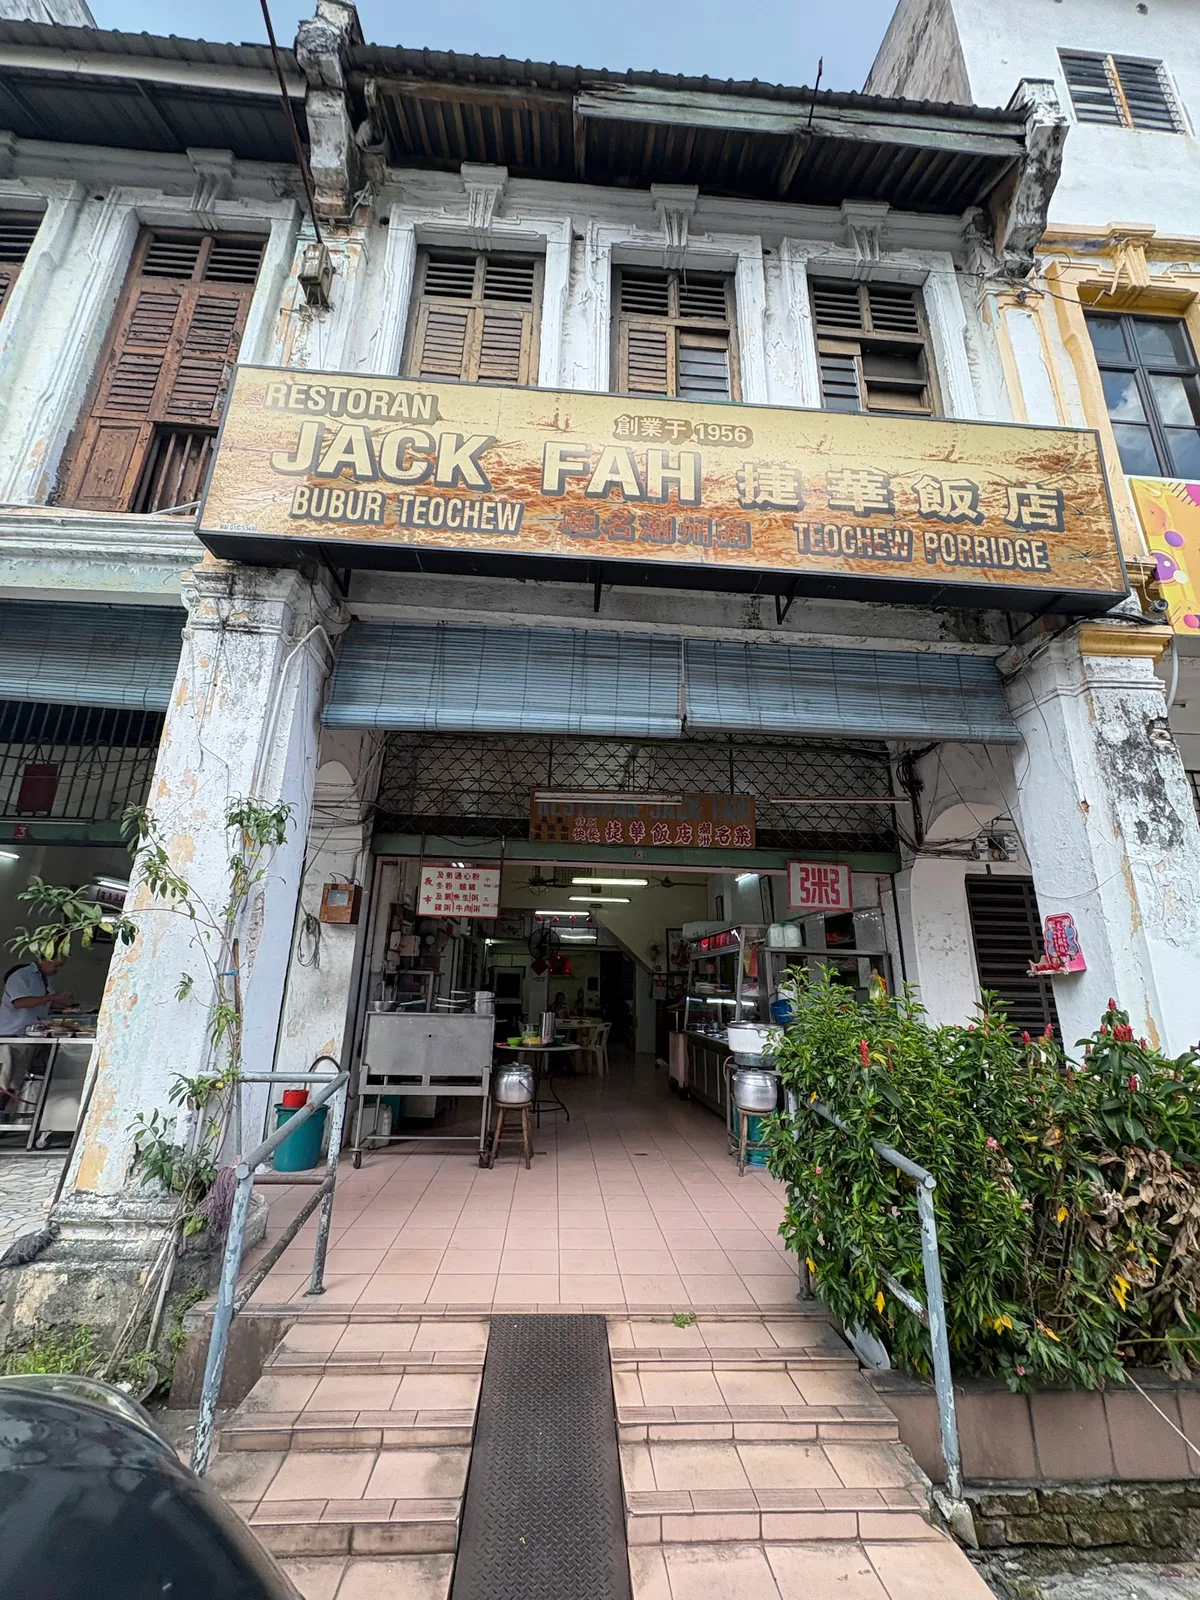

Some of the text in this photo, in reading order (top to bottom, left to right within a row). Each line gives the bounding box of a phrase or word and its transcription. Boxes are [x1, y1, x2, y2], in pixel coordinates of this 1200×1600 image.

[265, 382, 434, 420] RESTORAN
[616, 414, 748, 443] 創業于 1956
[270, 420, 697, 502] JACK FAH
[291, 485, 523, 532] BUBUR TEOCHEW
[736, 461, 1063, 529] 捷華飯店
[792, 520, 1048, 571] TEOCHEW PORRIDGE
[15, 826, 28, 837] 3
[604, 820, 693, 845] 捷華飯店
[799, 866, 840, 905] 粥
